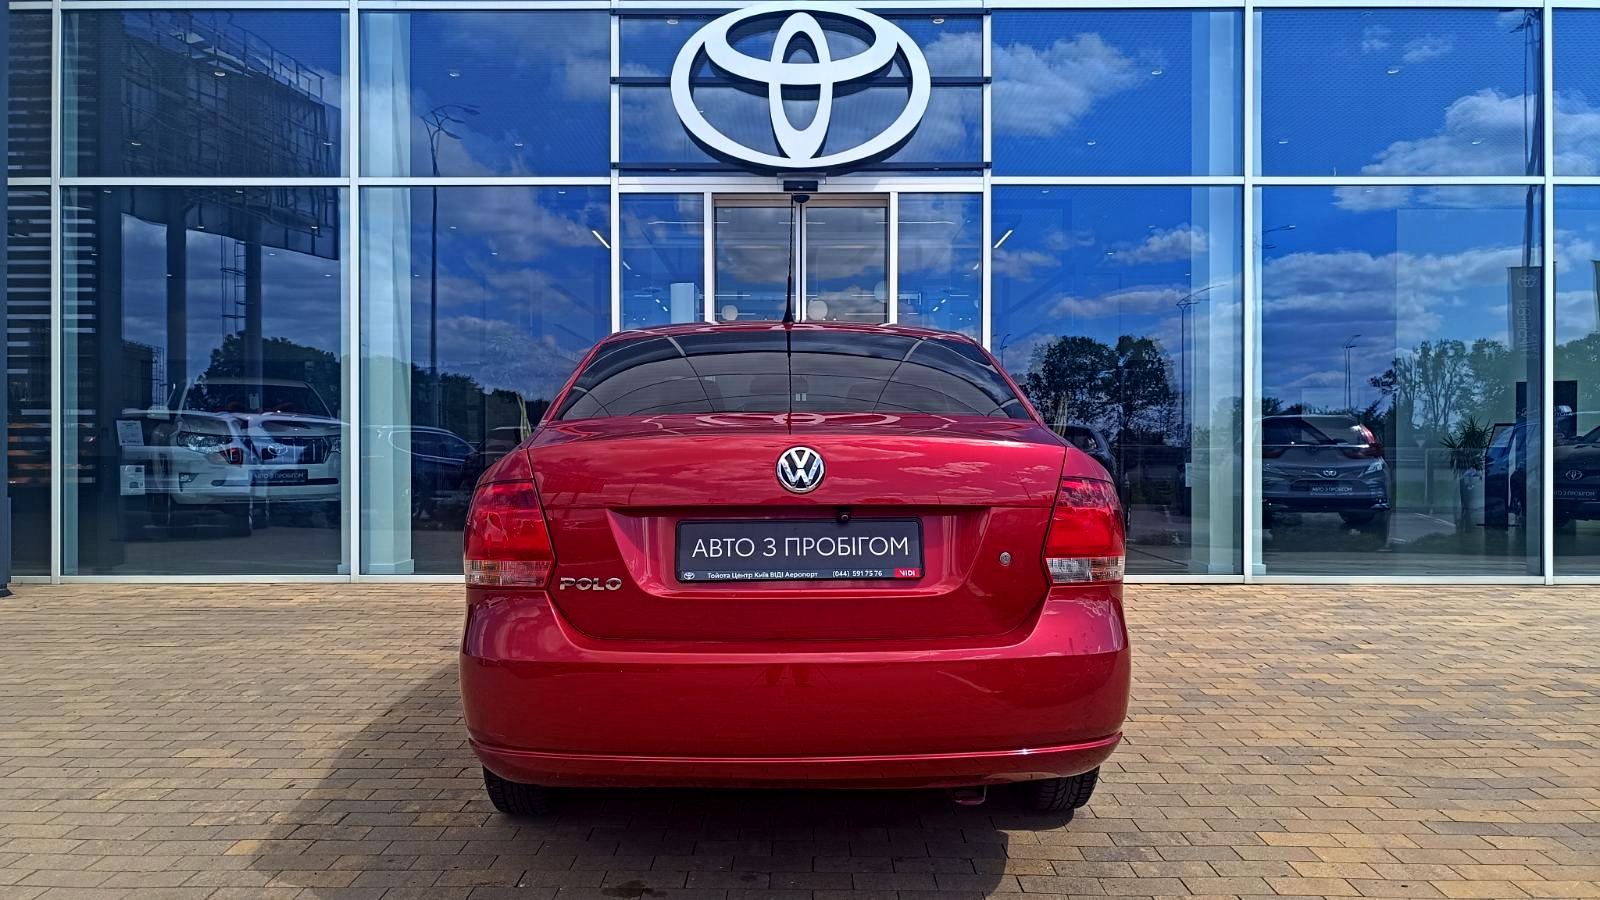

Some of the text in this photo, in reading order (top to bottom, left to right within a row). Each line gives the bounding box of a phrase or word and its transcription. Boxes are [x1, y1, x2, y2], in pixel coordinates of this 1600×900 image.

[692, 536, 909, 558] АВТО З ПРОБІГОМ
[731, 572, 753, 580] Центр
[785, 571, 818, 579] Аеропорт
[832, 570, 850, 578] (044)
[899, 569, 916, 577] VIDI
[559, 577, 622, 591] POLO
